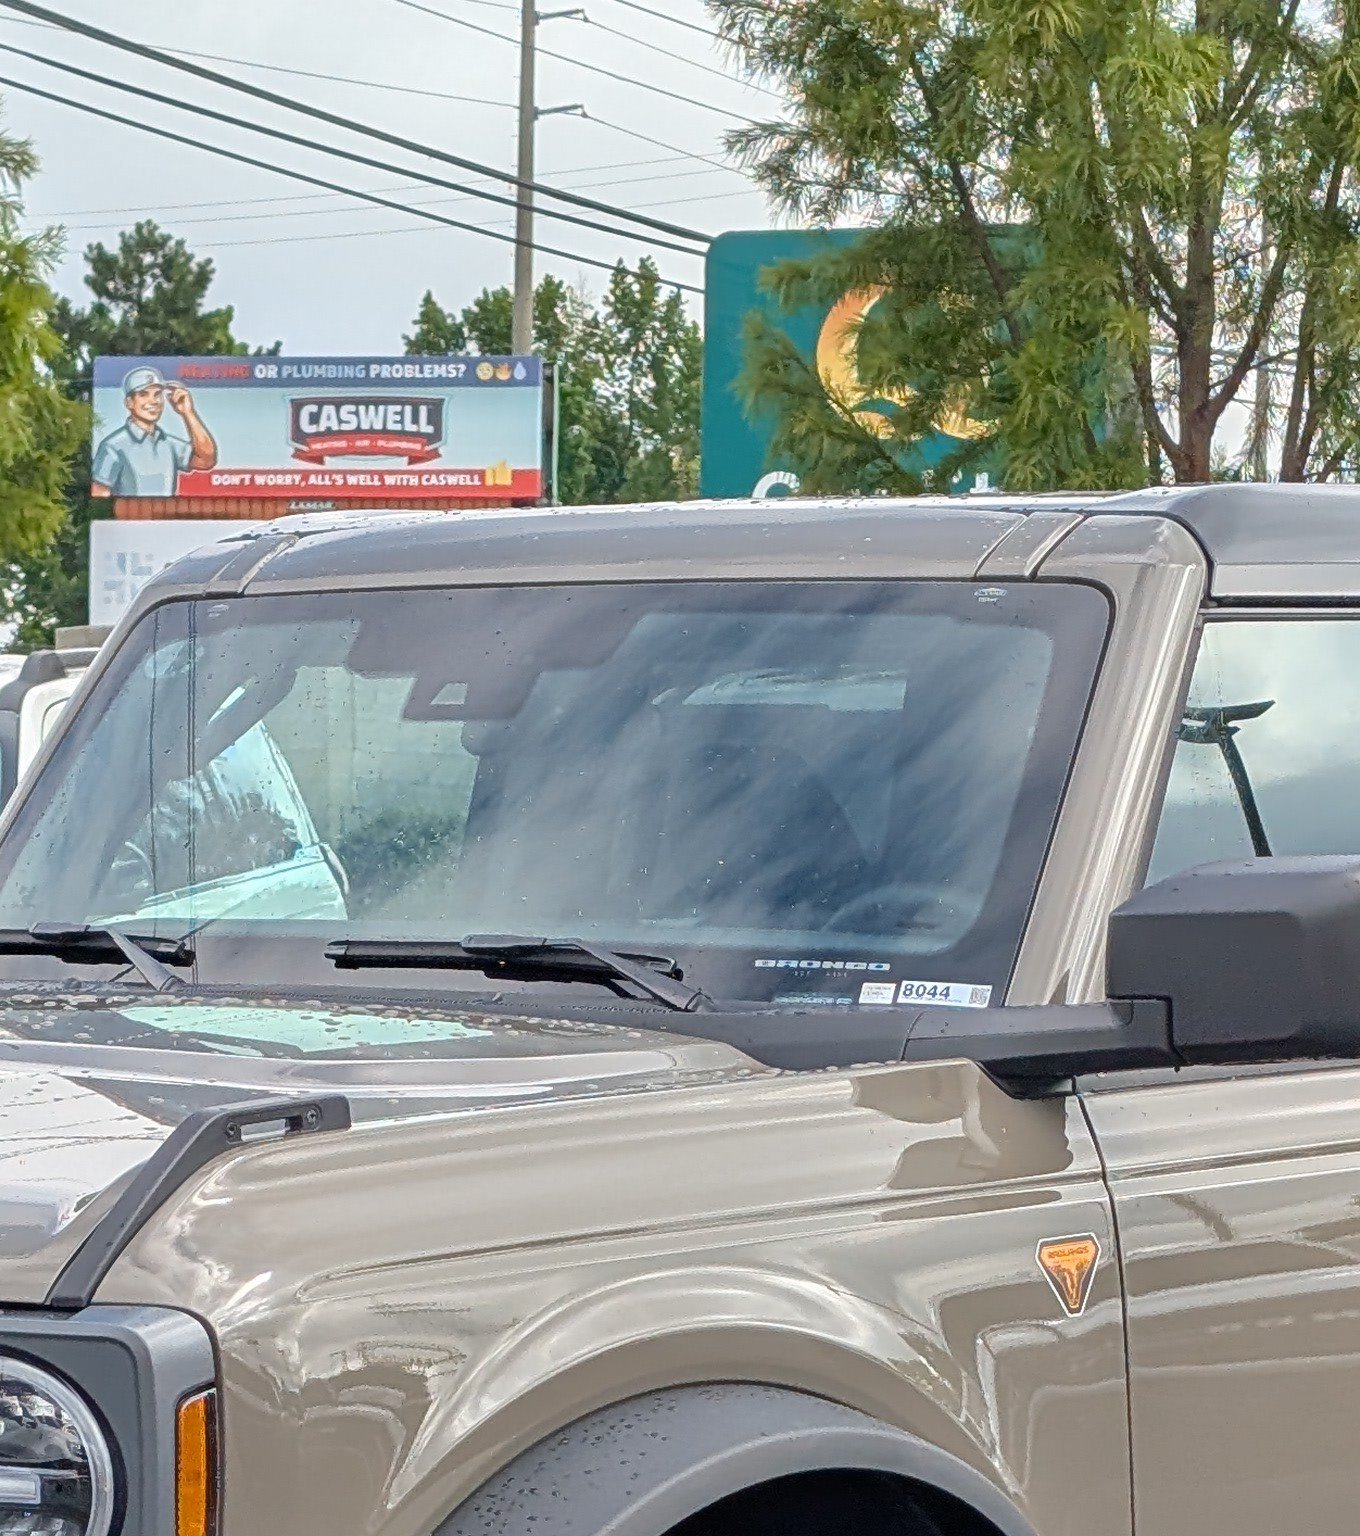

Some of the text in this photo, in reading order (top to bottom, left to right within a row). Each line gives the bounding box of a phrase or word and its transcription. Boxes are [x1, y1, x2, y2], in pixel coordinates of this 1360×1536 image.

[254, 364, 278, 378] OR
[281, 364, 366, 378] PLUMBING
[369, 363, 467, 378] PROBLEMS?
[299, 404, 434, 434] CASWELL
[211, 474, 481, 488] DON'T WORRY, ALL'S WELL WITH CASWELL
[902, 983, 951, 999] 8044
